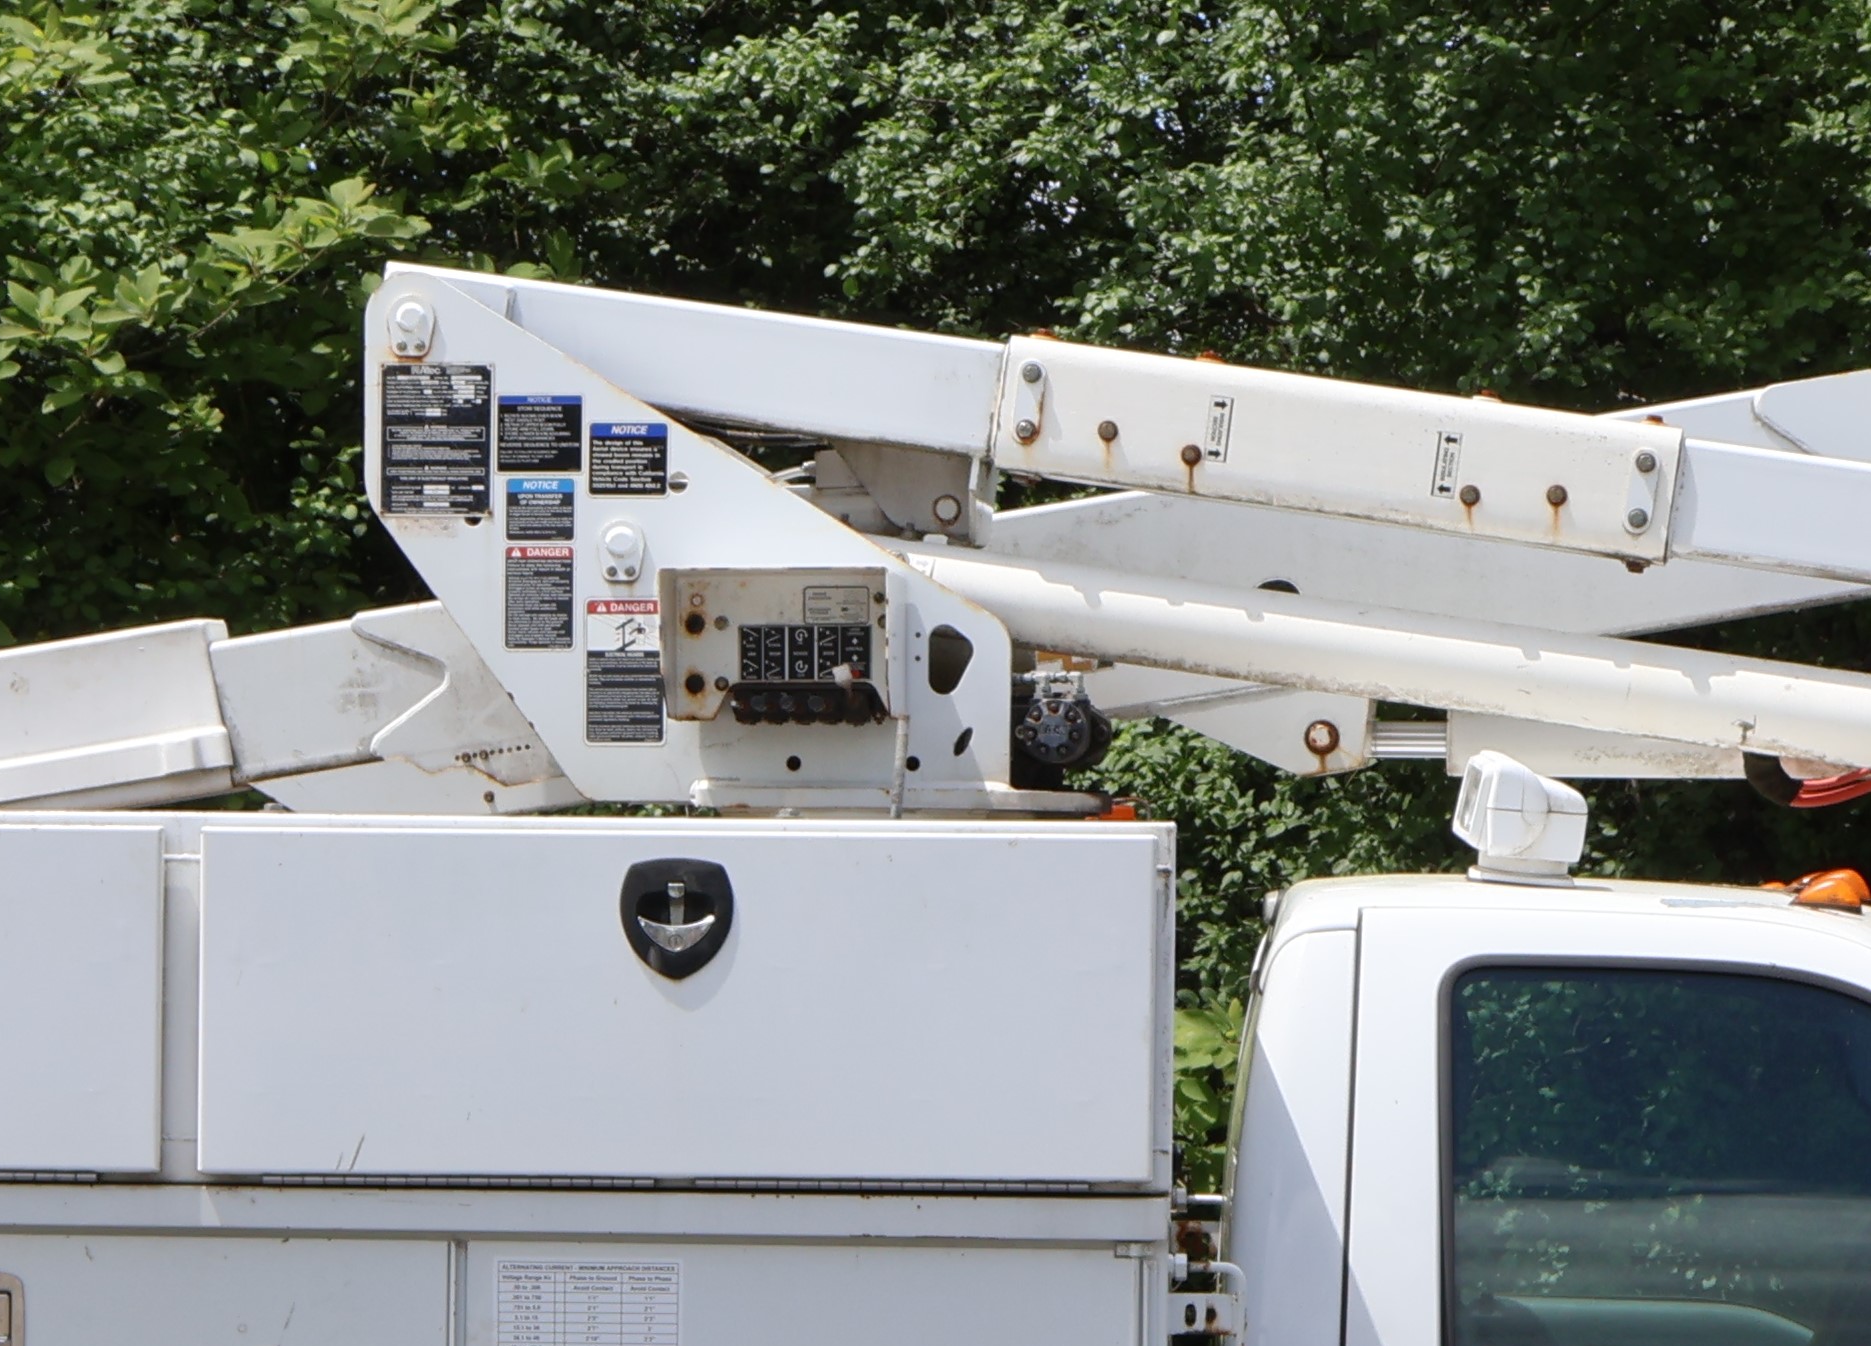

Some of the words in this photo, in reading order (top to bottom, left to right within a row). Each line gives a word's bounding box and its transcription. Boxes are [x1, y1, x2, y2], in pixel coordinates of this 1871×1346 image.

[611, 425, 648, 435] NOTICE
[523, 481, 559, 490] NOTICE
[527, 548, 569, 557] DANGER
[610, 603, 654, 612] DANGER
